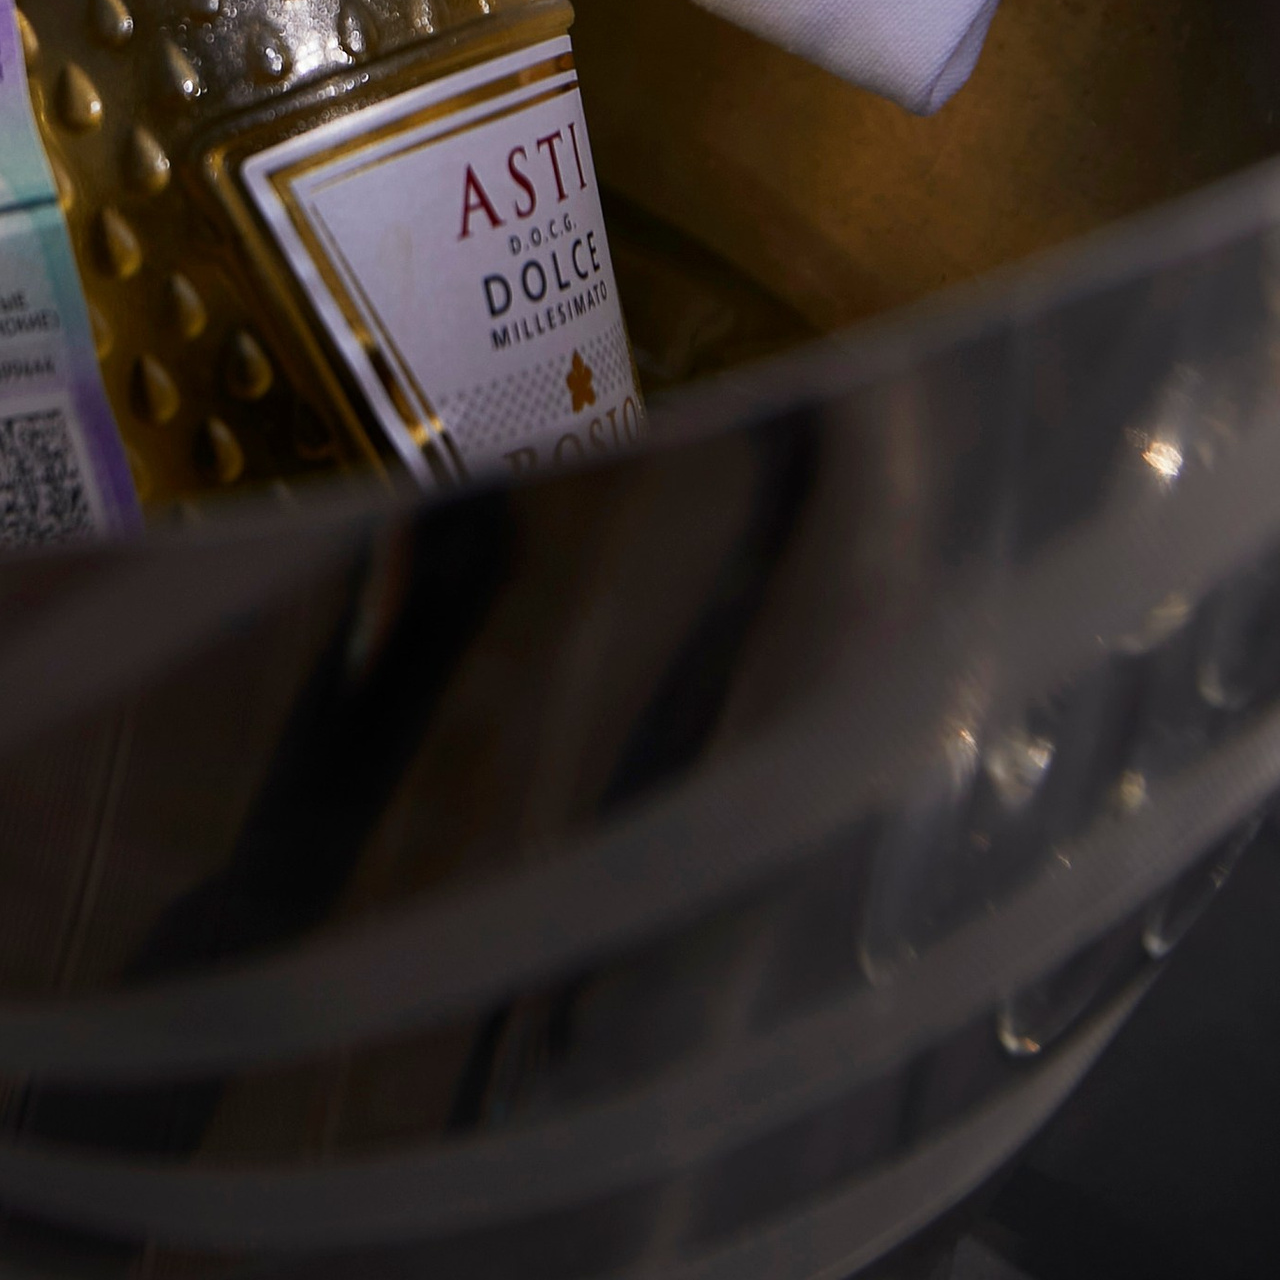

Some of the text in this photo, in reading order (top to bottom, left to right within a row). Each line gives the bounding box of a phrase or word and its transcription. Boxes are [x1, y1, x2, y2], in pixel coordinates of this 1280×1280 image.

[457, 122, 588, 239] ASTI
[483, 230, 601, 318] DOLCE
[508, 216, 578, 256] D.O.C.G.
[491, 283, 608, 350] MILLESIMATO
